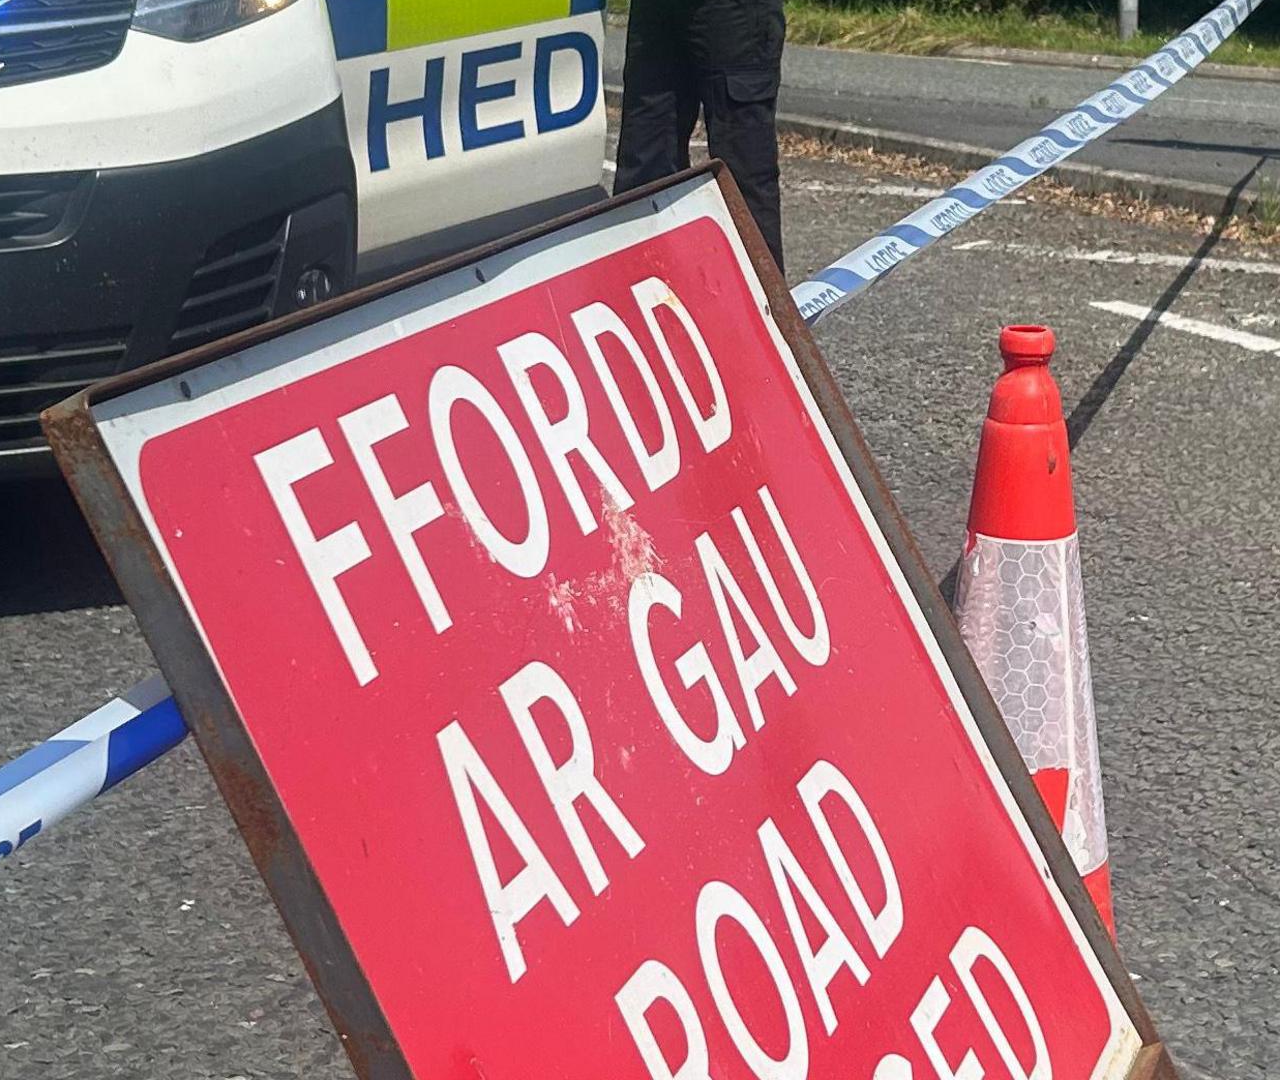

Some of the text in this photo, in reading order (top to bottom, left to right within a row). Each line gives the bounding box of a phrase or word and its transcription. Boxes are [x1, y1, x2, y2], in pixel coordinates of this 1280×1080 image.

[367, 31, 600, 173] HED
[253, 276, 733, 687] FFORDD
[436, 485, 831, 984] AR GAU
